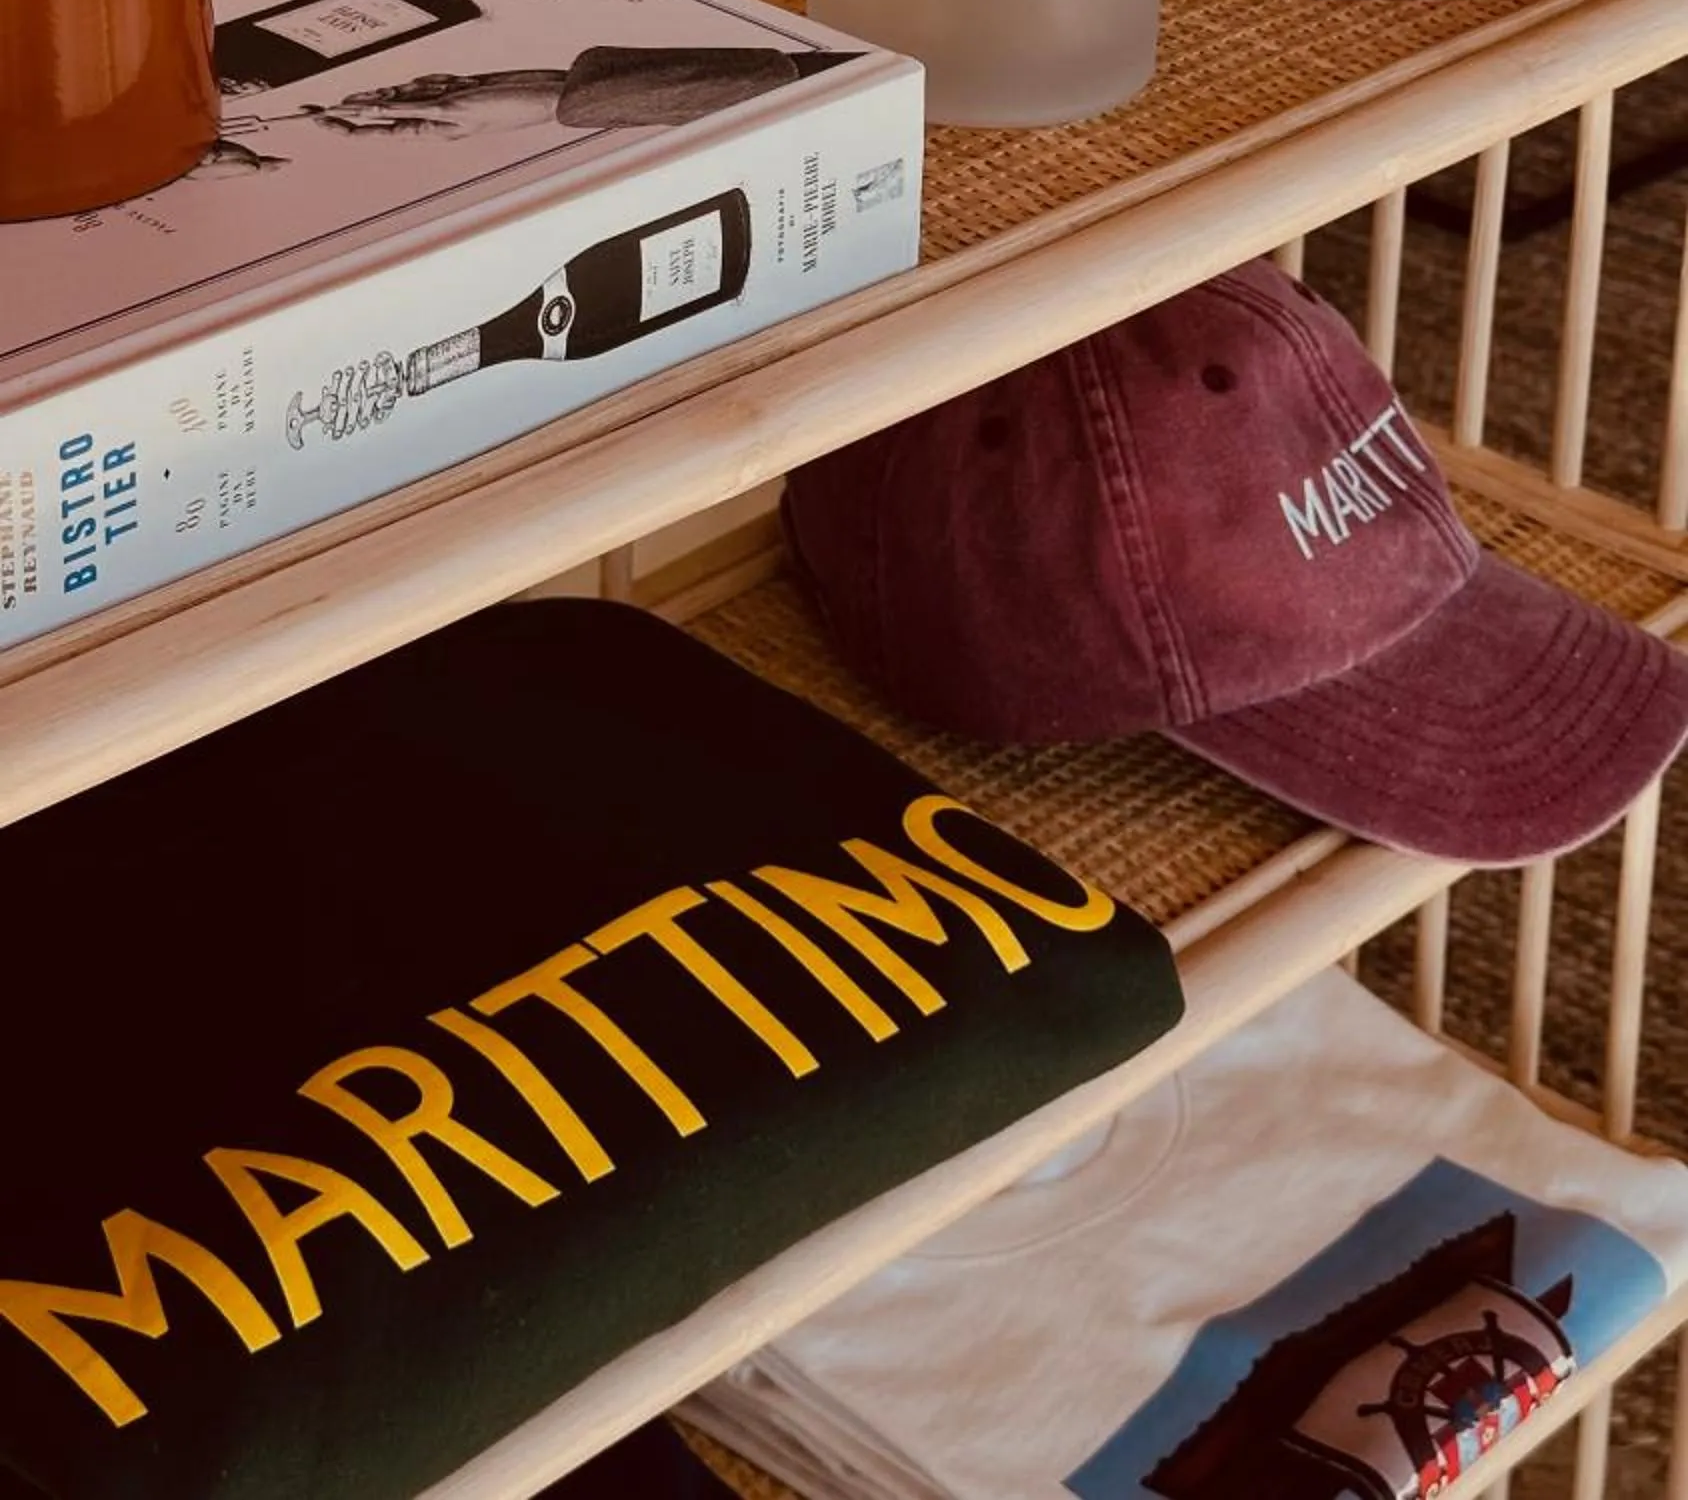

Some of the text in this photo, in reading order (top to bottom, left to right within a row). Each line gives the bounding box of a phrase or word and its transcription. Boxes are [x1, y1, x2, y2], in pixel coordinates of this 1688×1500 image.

[20, 471, 37, 594] REYNAUD
[59, 433, 98, 594] BISTRO
[103, 441, 139, 546] TIER
[175, 498, 206, 533] 80
[0, 793, 1116, 1427] MARITTIMO
